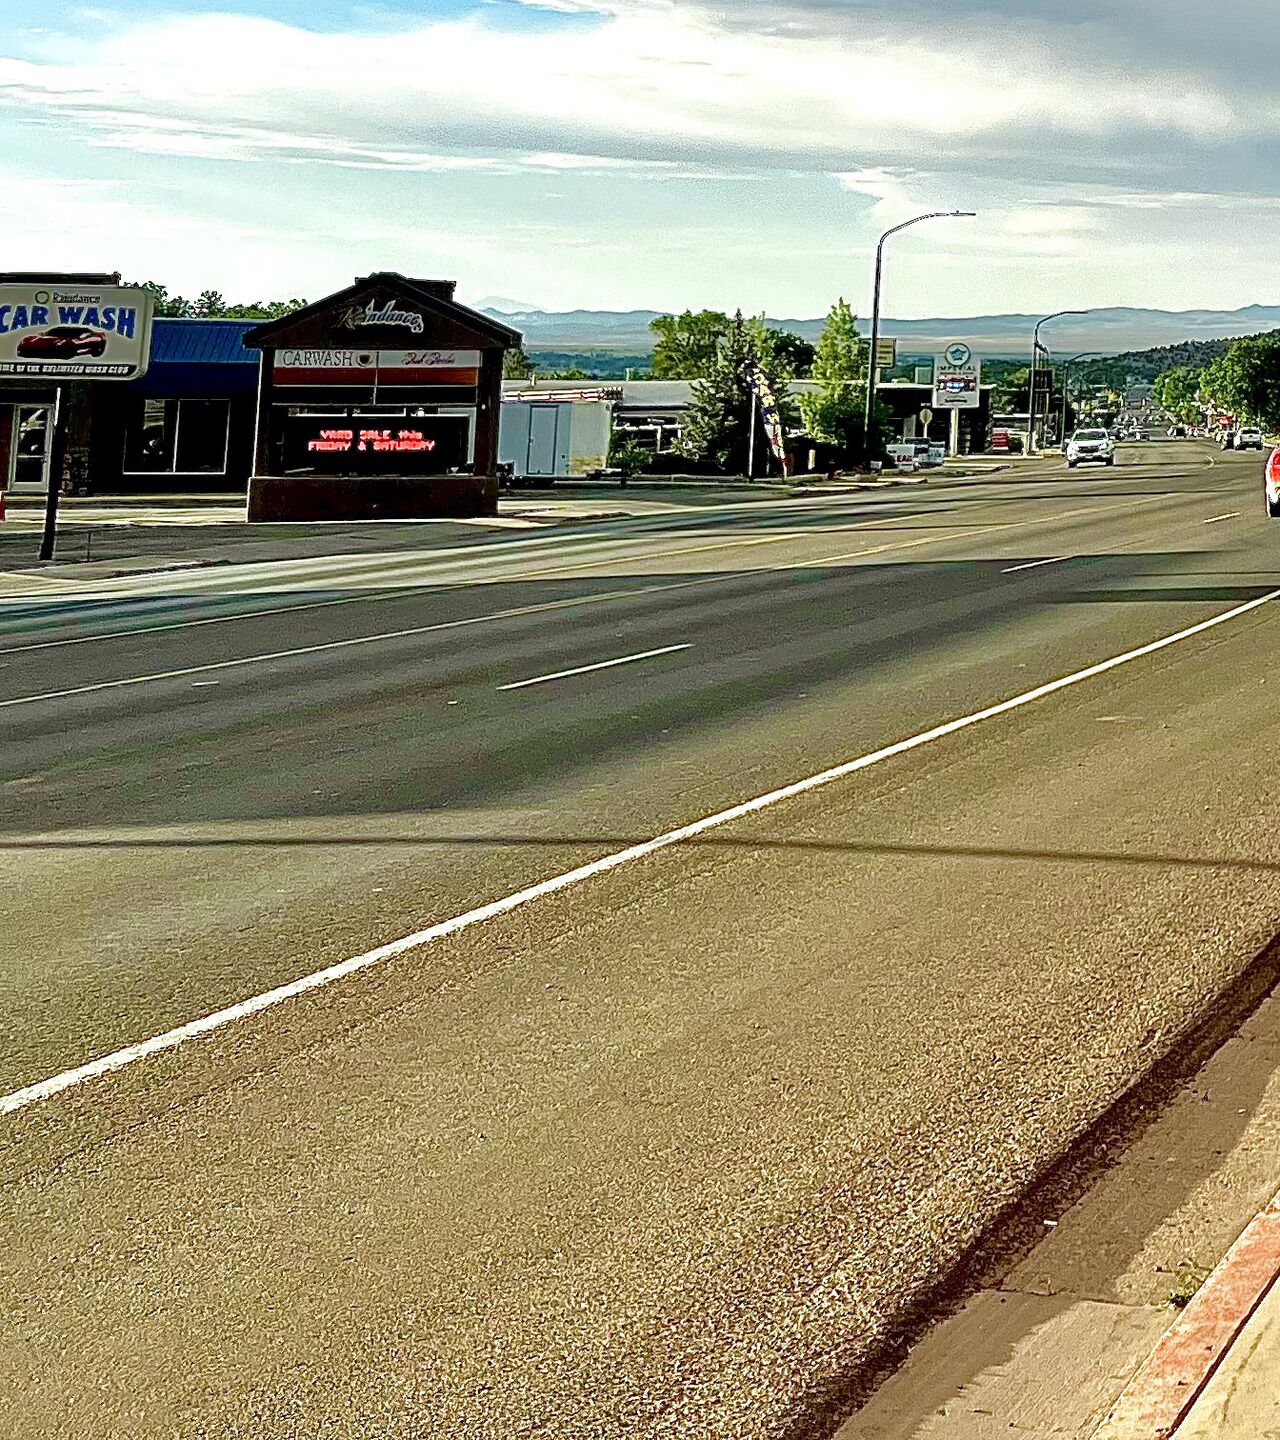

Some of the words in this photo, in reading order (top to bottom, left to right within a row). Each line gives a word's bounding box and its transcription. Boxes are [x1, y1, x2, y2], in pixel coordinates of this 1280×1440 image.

[0, 305, 48, 334] CAR
[58, 306, 136, 339] WASH
[283, 350, 353, 367] CARWASH
[320, 430, 353, 440] YARD
[359, 430, 392, 440] SALE
[308, 441, 352, 451] FRIDAY
[357, 441, 367, 451] &
[373, 440, 436, 451] SATURDAY
